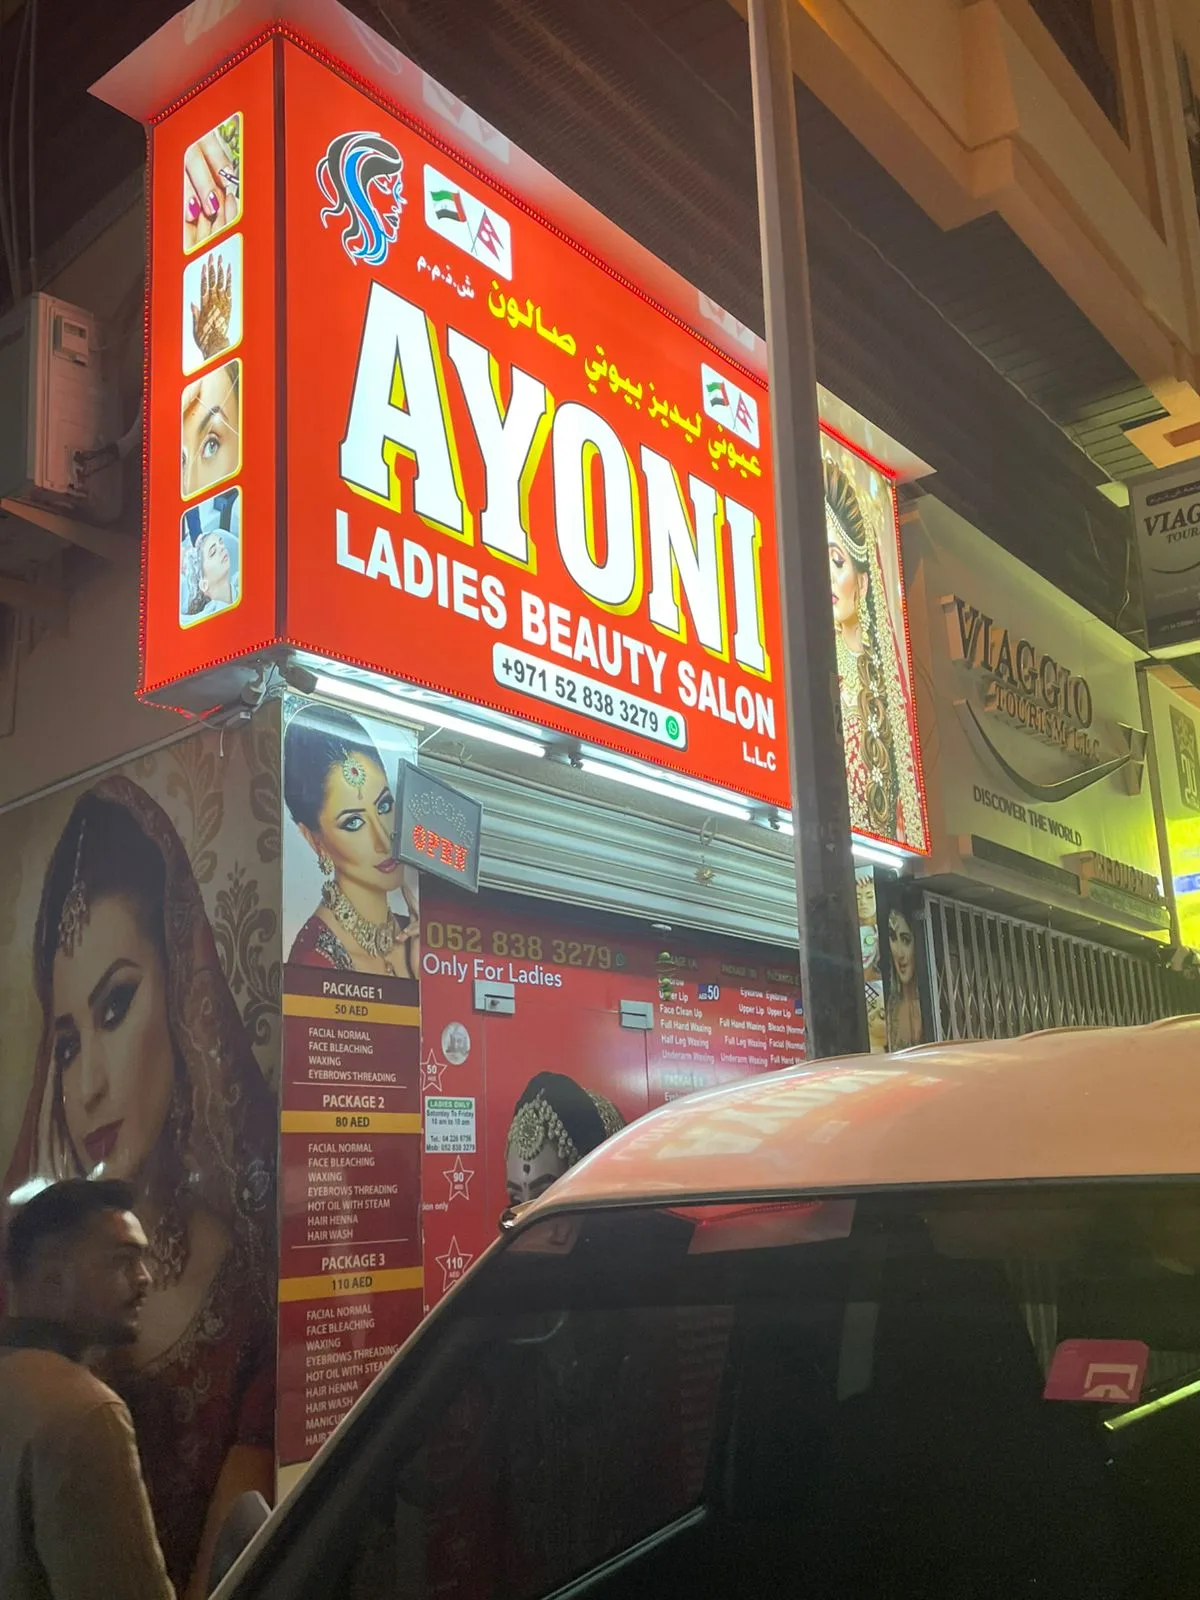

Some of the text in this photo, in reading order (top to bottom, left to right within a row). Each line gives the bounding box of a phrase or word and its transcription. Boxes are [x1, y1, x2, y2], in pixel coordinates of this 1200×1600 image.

[488, 280, 577, 356] صالون
[585, 344, 643, 410] بيوتي
[648, 382, 702, 443] ليديز
[708, 424, 762, 478] عيوني
[339, 279, 772, 681] AYONI
[335, 509, 776, 740] LADIES BEAUTY SALON
[944, 594, 1093, 728] VIAGGIO
[502, 657, 659, 733] +971 52 838 3279
[992, 684, 1066, 745] TOURISM
[743, 741, 777, 772] L.L.C
[973, 784, 1082, 847] DISCOVER THE WORLD
[426, 921, 612, 970] 052 838 3279
[423, 953, 562, 987] Only For Ladies
[323, 981, 383, 999] PACKAGE 1
[678, 992, 688, 1003] Lip
[708, 984, 719, 1000] 50
[335, 1004, 368, 1017] 50 AED
[660, 1003, 675, 1015] Face
[693, 1007, 703, 1019] Up
[309, 1027, 371, 1041] FACIAL NORMAL
[309, 1042, 373, 1055] FACE BLEACHING
[309, 1056, 342, 1066] WAXING
[427, 1064, 438, 1074] 50
[309, 1069, 396, 1083] EYEBROWS THREADING
[323, 1094, 385, 1109] PACKAGE 2
[335, 1116, 370, 1128] 80 AED
[308, 1143, 372, 1153] FACIAL NORMAL
[308, 1157, 375, 1168] FACE BLEACHING
[308, 1171, 342, 1182] WAXING
[453, 1172, 464, 1182] 90
[308, 1184, 398, 1197] EYEBROWS THREADING
[308, 1198, 390, 1212] HOT OIL WITH STEAM
[434, 1202, 448, 1213] only
[307, 1214, 358, 1227] HAIR HENNA
[307, 1229, 353, 1241] HAIR WASH
[321, 1253, 386, 1271] PACKAGE 3
[446, 1257, 463, 1269] 110
[331, 1275, 373, 1291] 110 AED
[307, 1304, 372, 1321] FACIAL NORMAL
[306, 1318, 375, 1336] FACE BLEACHING
[306, 1338, 341, 1351] WAXING
[306, 1344, 399, 1367] EYEBROWS THREADING
[306, 1370, 324, 1382] HOT
[326, 1369, 339, 1379] OIL
[341, 1365, 363, 1377] WITH
[306, 1381, 358, 1398] HAIR HENNA
[306, 1396, 354, 1413] HAIR WASH
[305, 1432, 327, 1446] HAIR
